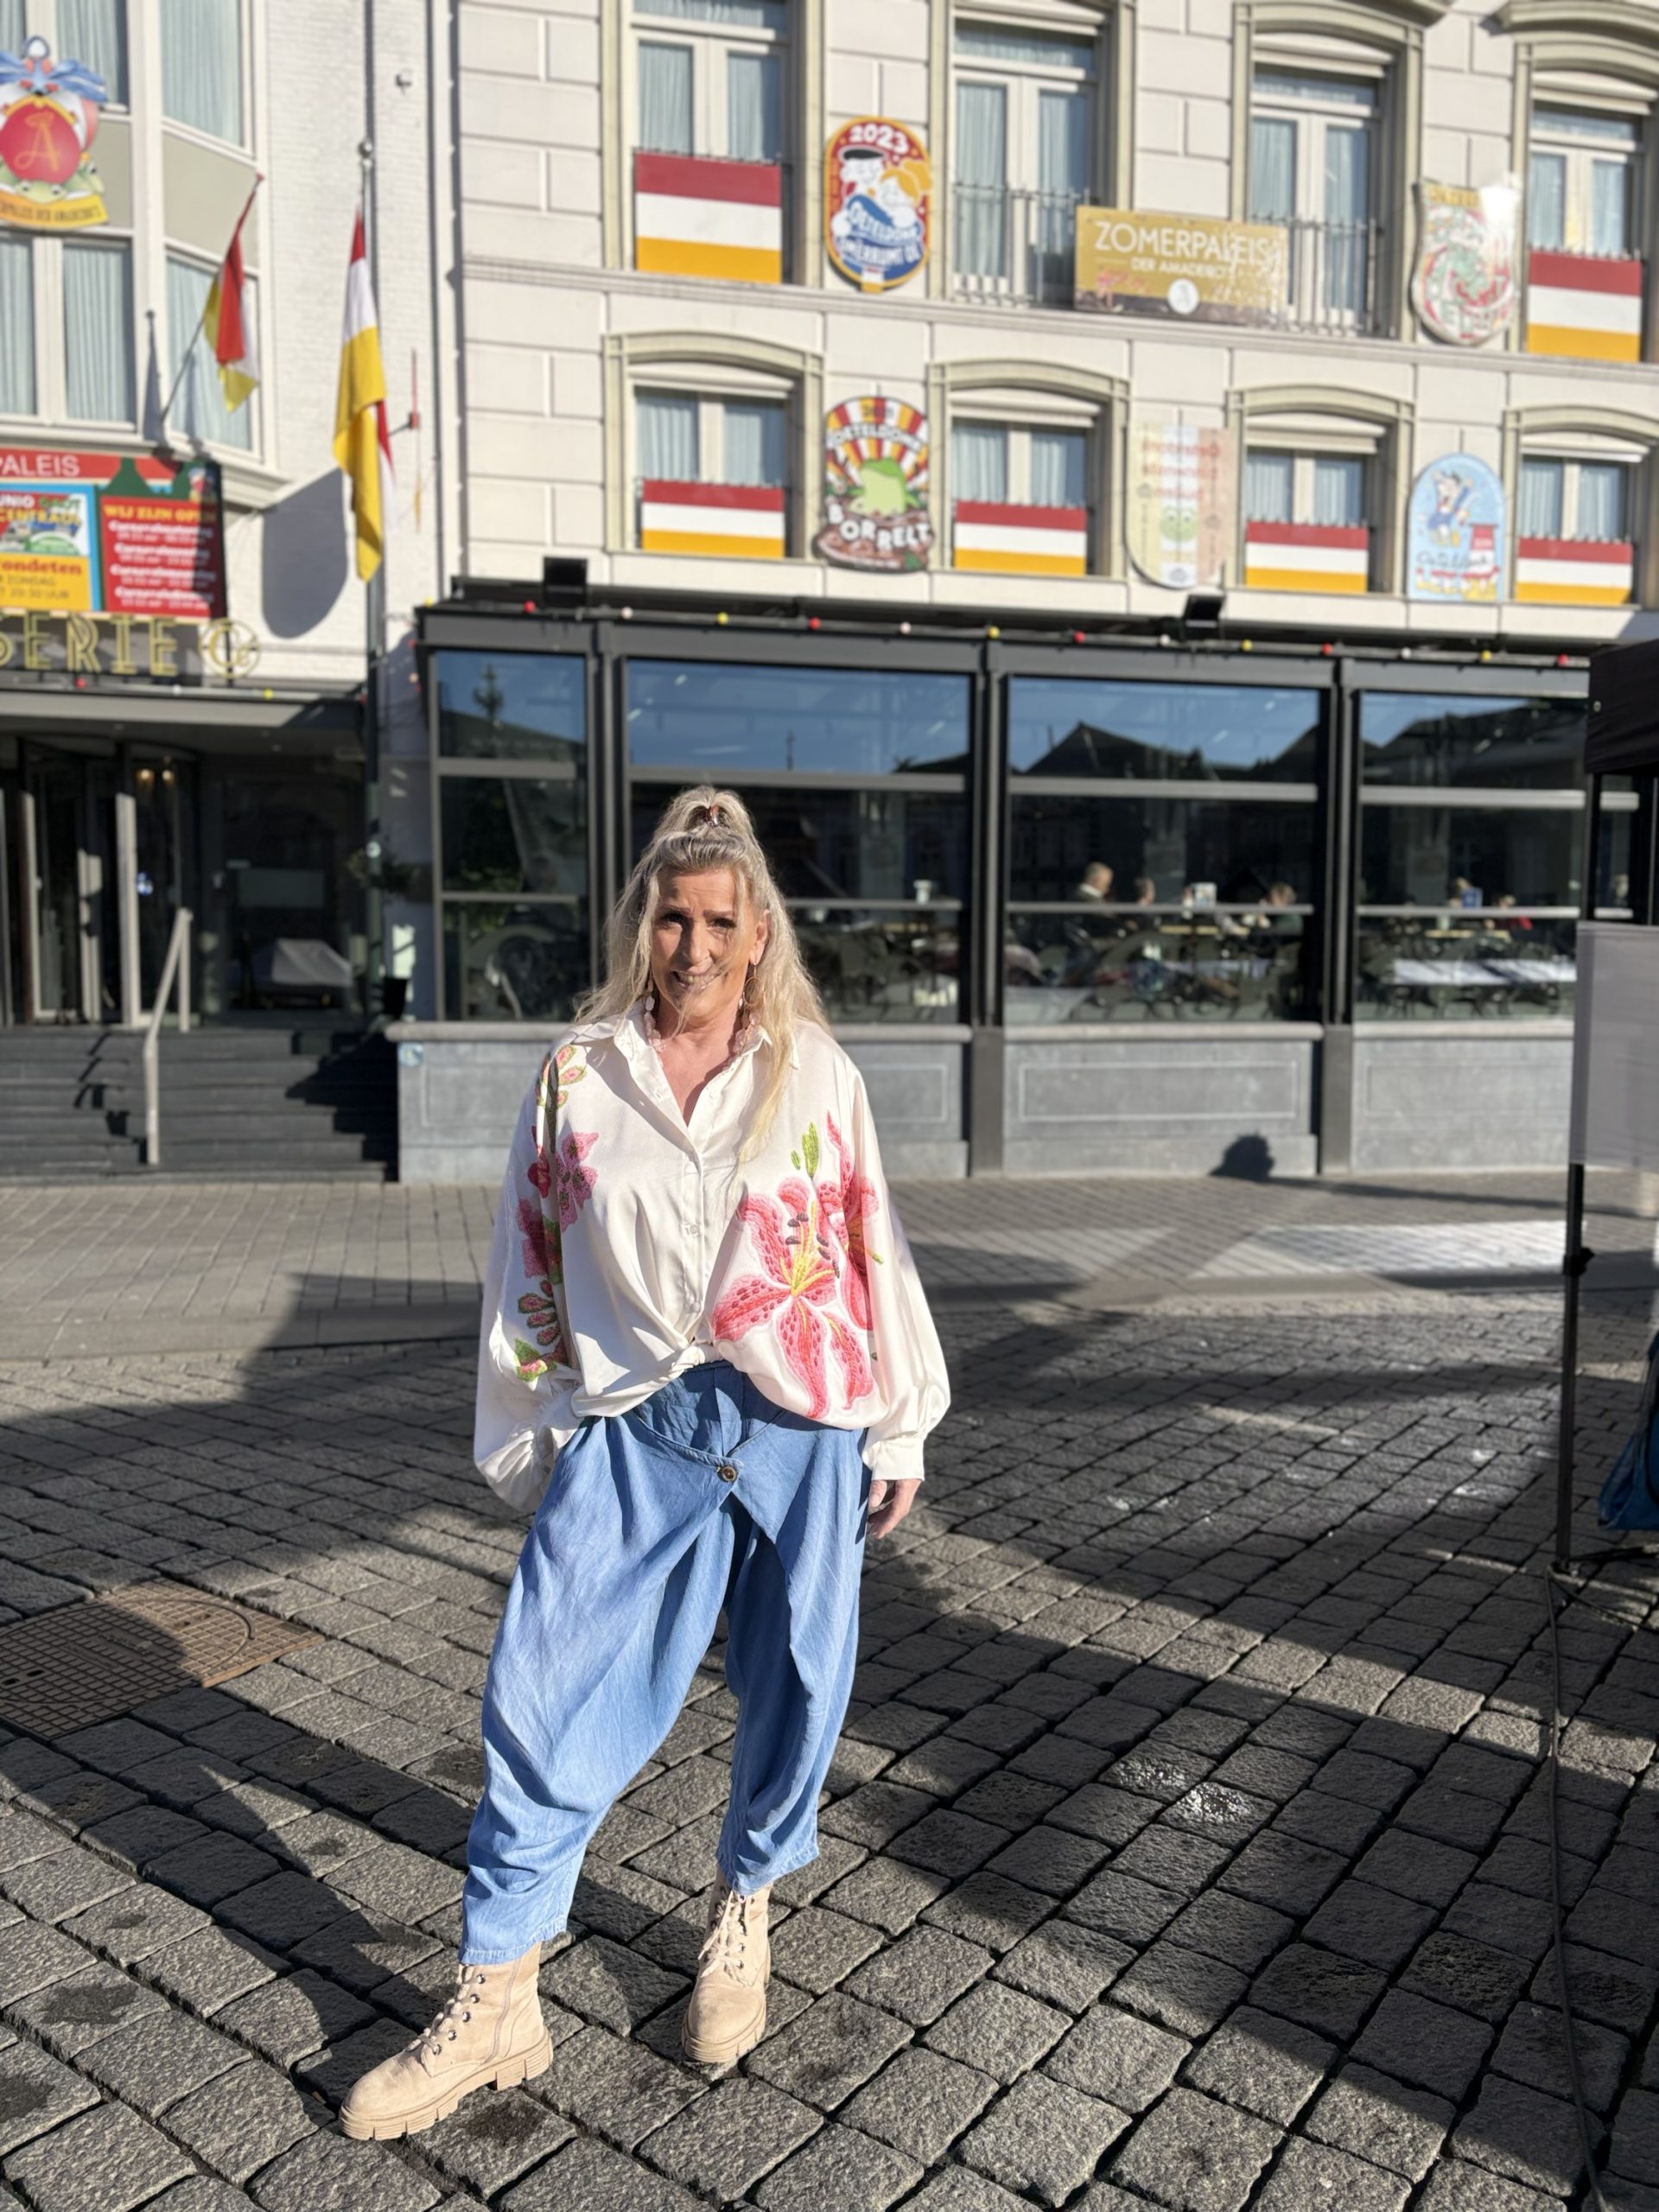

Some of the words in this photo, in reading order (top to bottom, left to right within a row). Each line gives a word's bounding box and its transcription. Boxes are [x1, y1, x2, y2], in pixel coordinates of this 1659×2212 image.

[849, 123, 910, 156] 2023
[1094, 221, 1272, 266] ZOMERPALEIS
[0, 454, 80, 477] ALEIS
[104, 505, 134, 518] WIJ
[0, 558, 82, 575] ondeten
